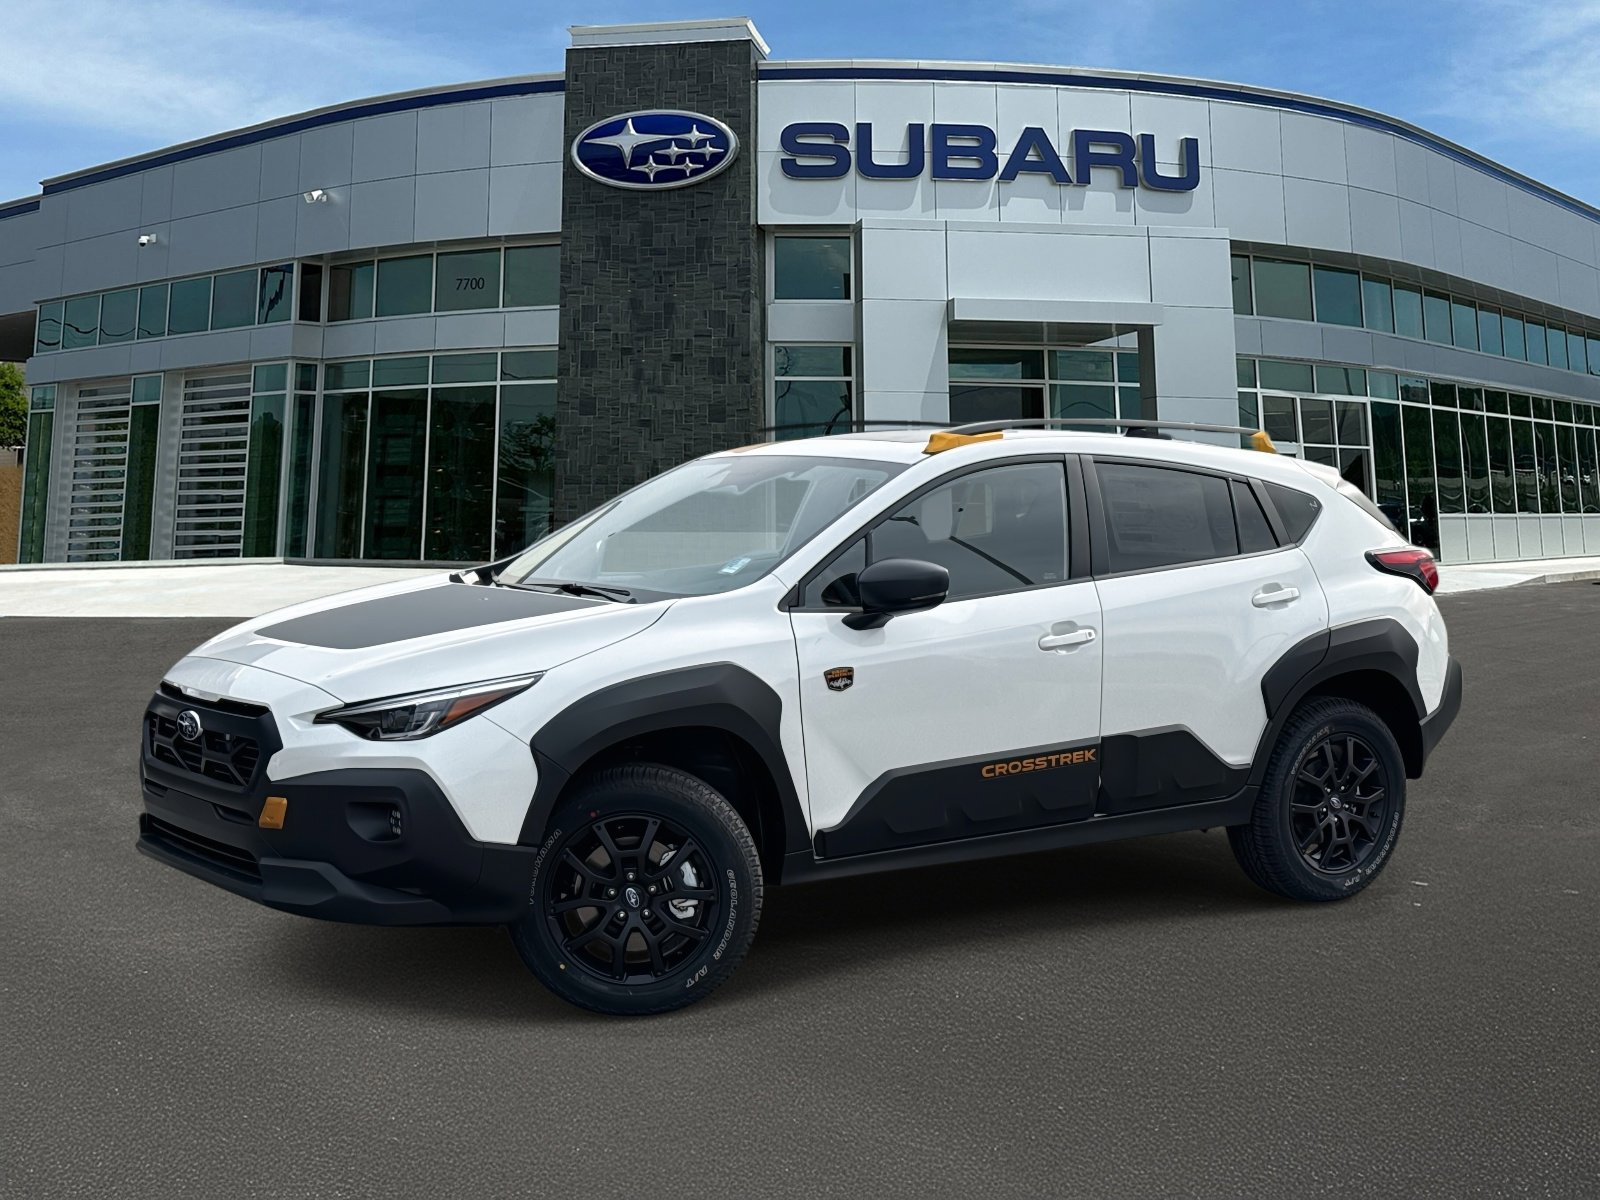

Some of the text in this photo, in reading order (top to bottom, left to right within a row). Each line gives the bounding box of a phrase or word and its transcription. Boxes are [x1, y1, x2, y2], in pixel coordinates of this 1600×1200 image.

[780, 122, 1201, 192] SUBARU
[455, 277, 485, 290] 7700
[981, 748, 1097, 778] CROSSTREK
[686, 869, 738, 988] GEOLANDAR A/T
